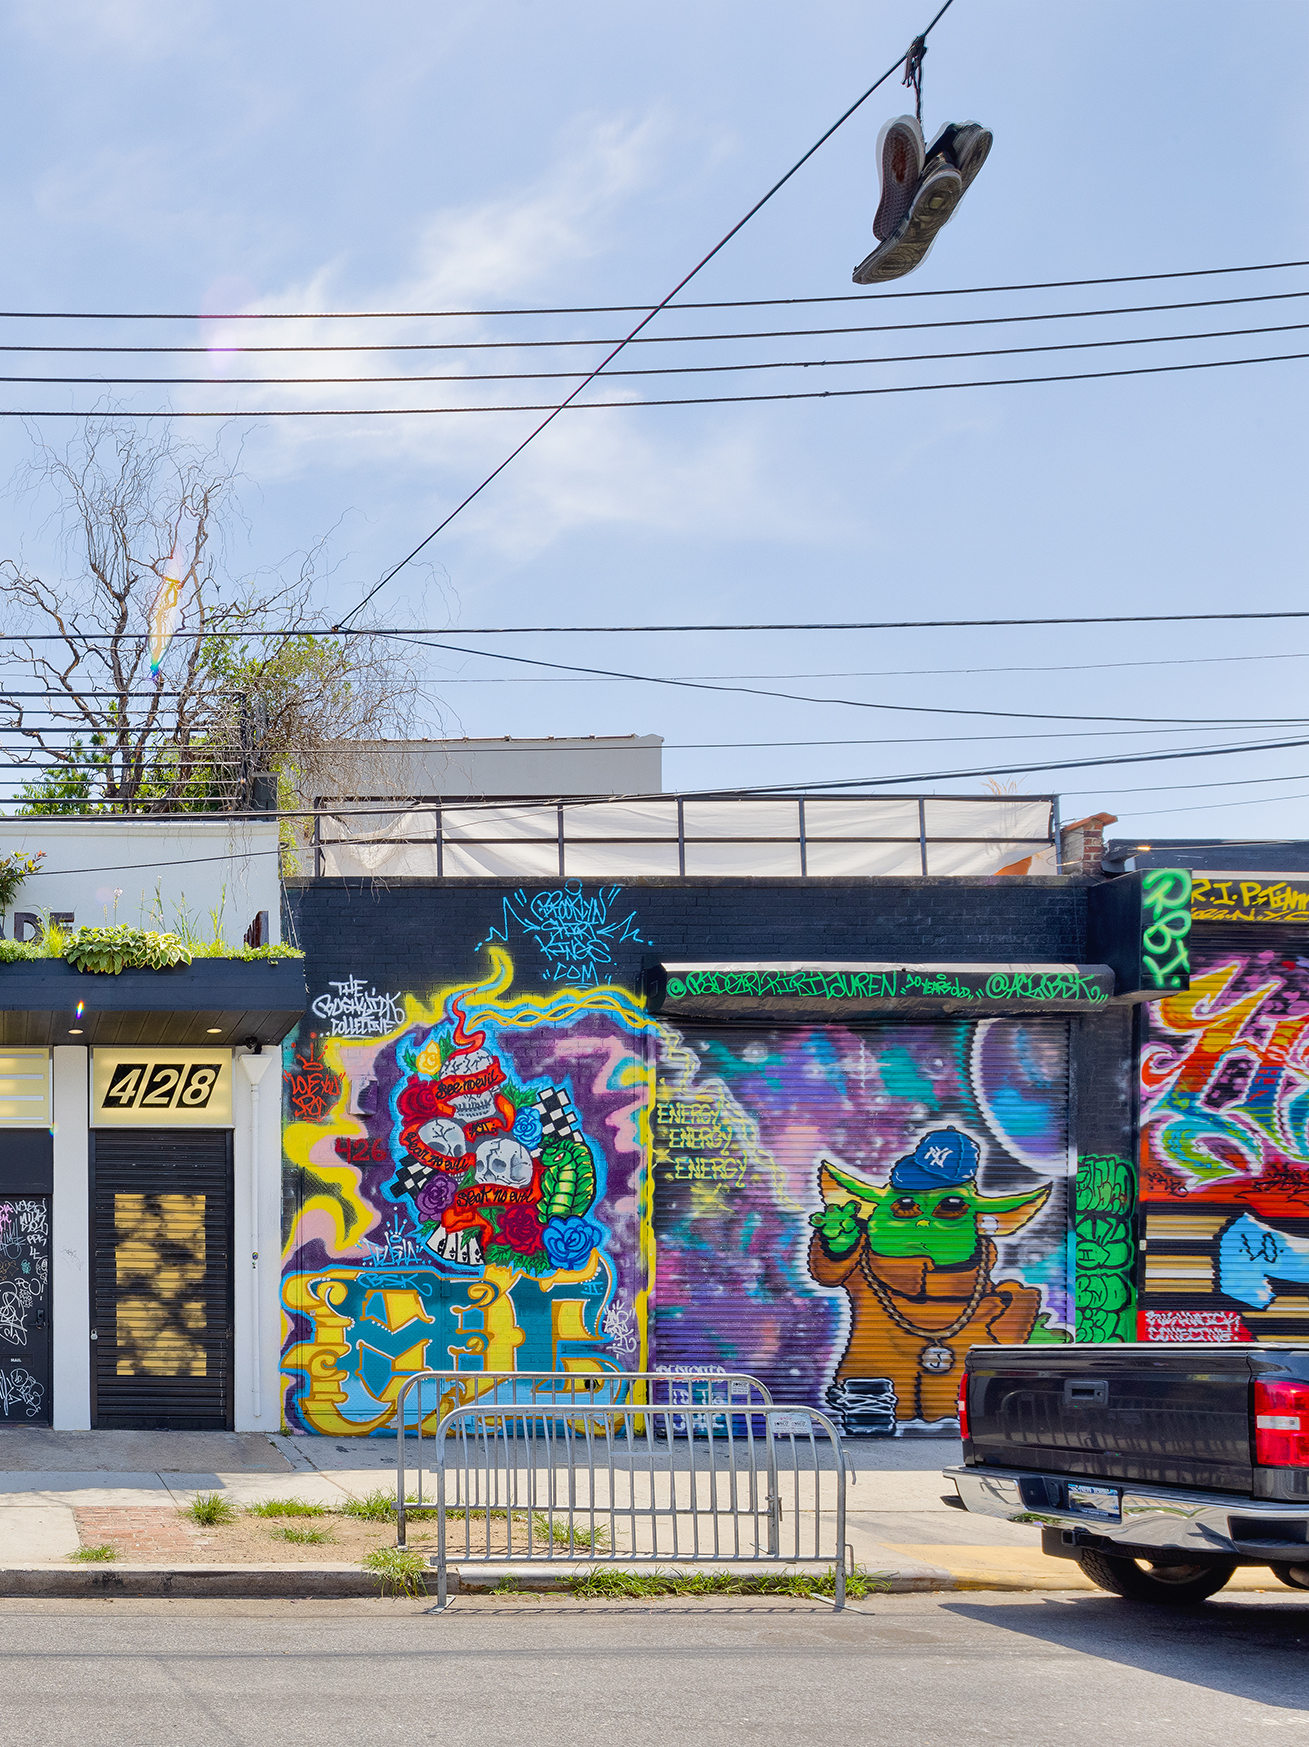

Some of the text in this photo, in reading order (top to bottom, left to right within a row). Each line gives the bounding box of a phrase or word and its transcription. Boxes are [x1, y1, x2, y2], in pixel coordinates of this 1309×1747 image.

[328, 974, 369, 996] THE
[107, 1068, 217, 1105] 428
[656, 1101, 722, 1130] ENERGY
[334, 1137, 387, 1164] 426
[669, 1126, 732, 1156] ENERGY
[674, 1150, 747, 1188] ENERGY
